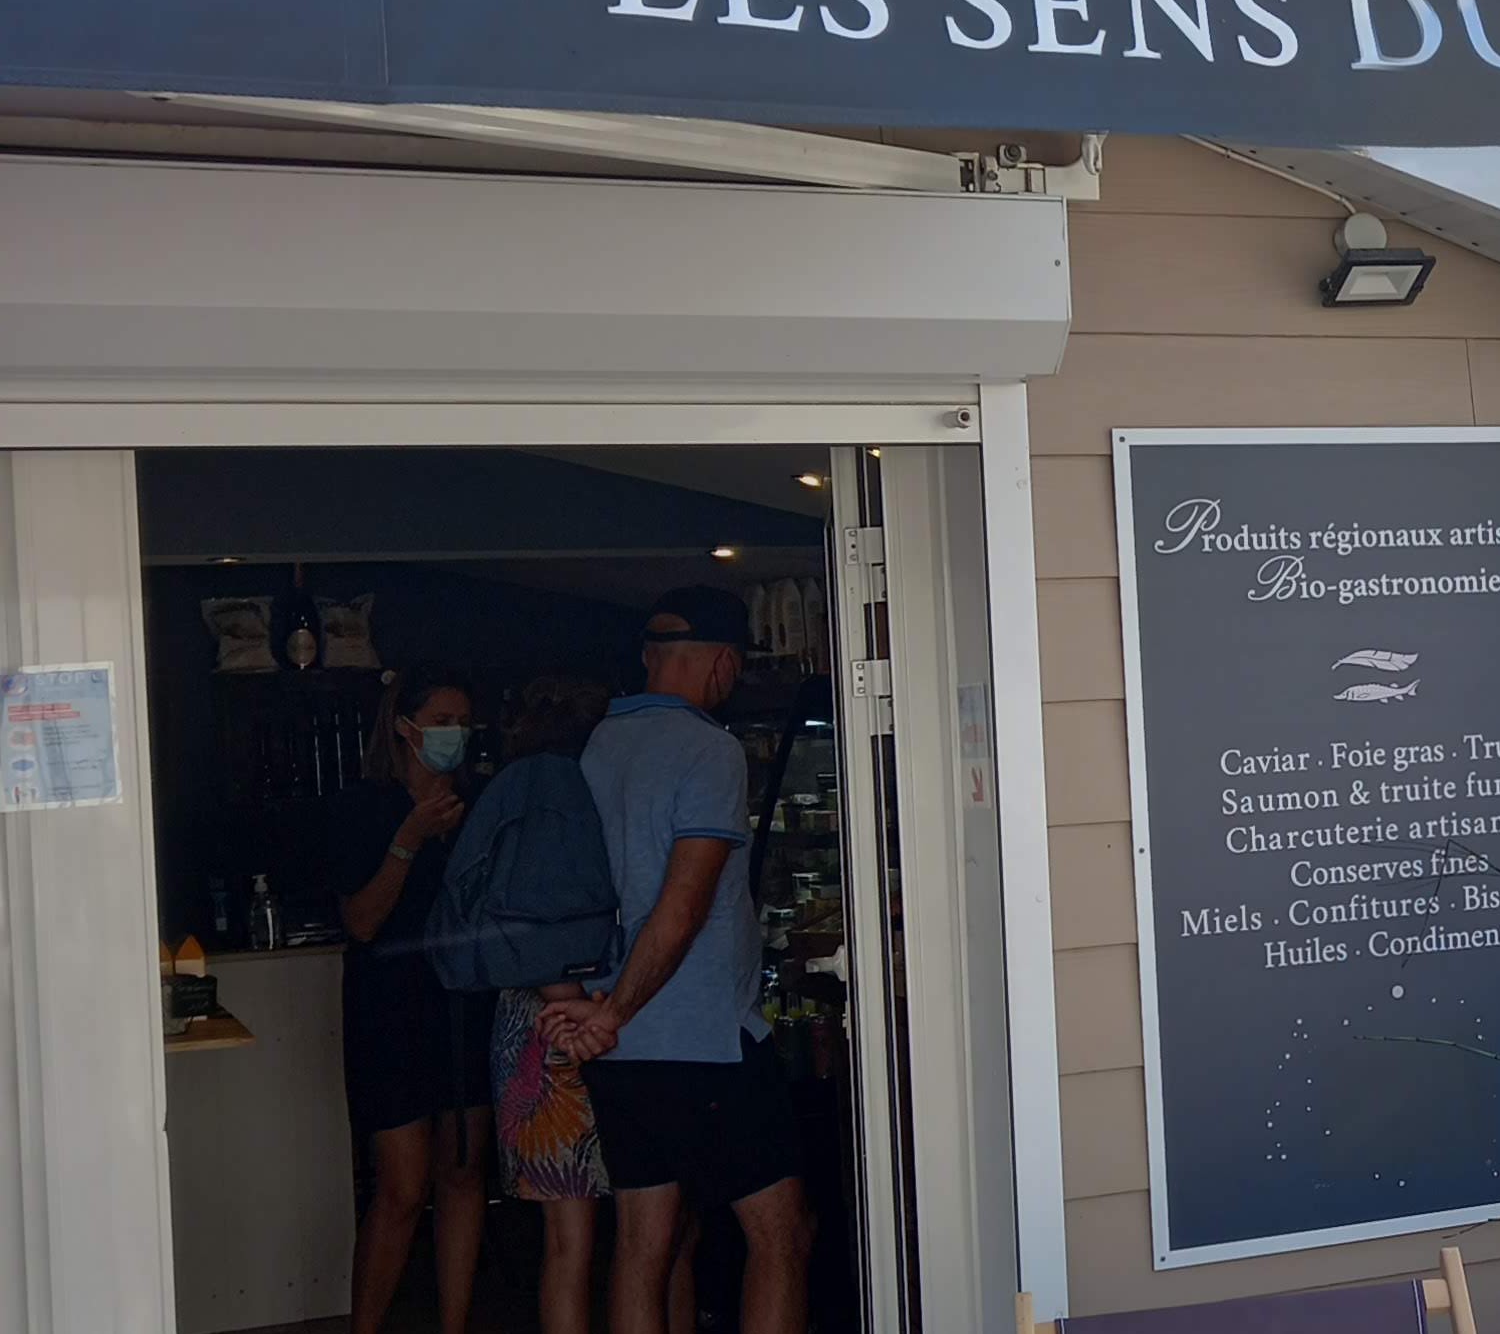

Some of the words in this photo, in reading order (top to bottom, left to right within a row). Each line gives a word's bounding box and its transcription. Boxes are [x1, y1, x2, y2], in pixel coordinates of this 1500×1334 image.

[1155, 499, 1301, 553] Produits
[1309, 523, 1443, 555] régionaux
[1248, 555, 1500, 604] Bio-gastronomie
[1221, 748, 1310, 775] Caviar
[1331, 741, 1385, 768] Foie
[1394, 745, 1444, 771] gras
[1223, 789, 1339, 814] Saumon
[1350, 780, 1370, 805] &
[1380, 776, 1456, 803] truite
[1227, 817, 1398, 853] Charcuterie
[1291, 860, 1423, 886] Conserves
[1431, 849, 1488, 875] fines
[1181, 905, 1262, 936] Miels
[1289, 894, 1439, 925] Confitures
[1264, 937, 1347, 968] Huiles
